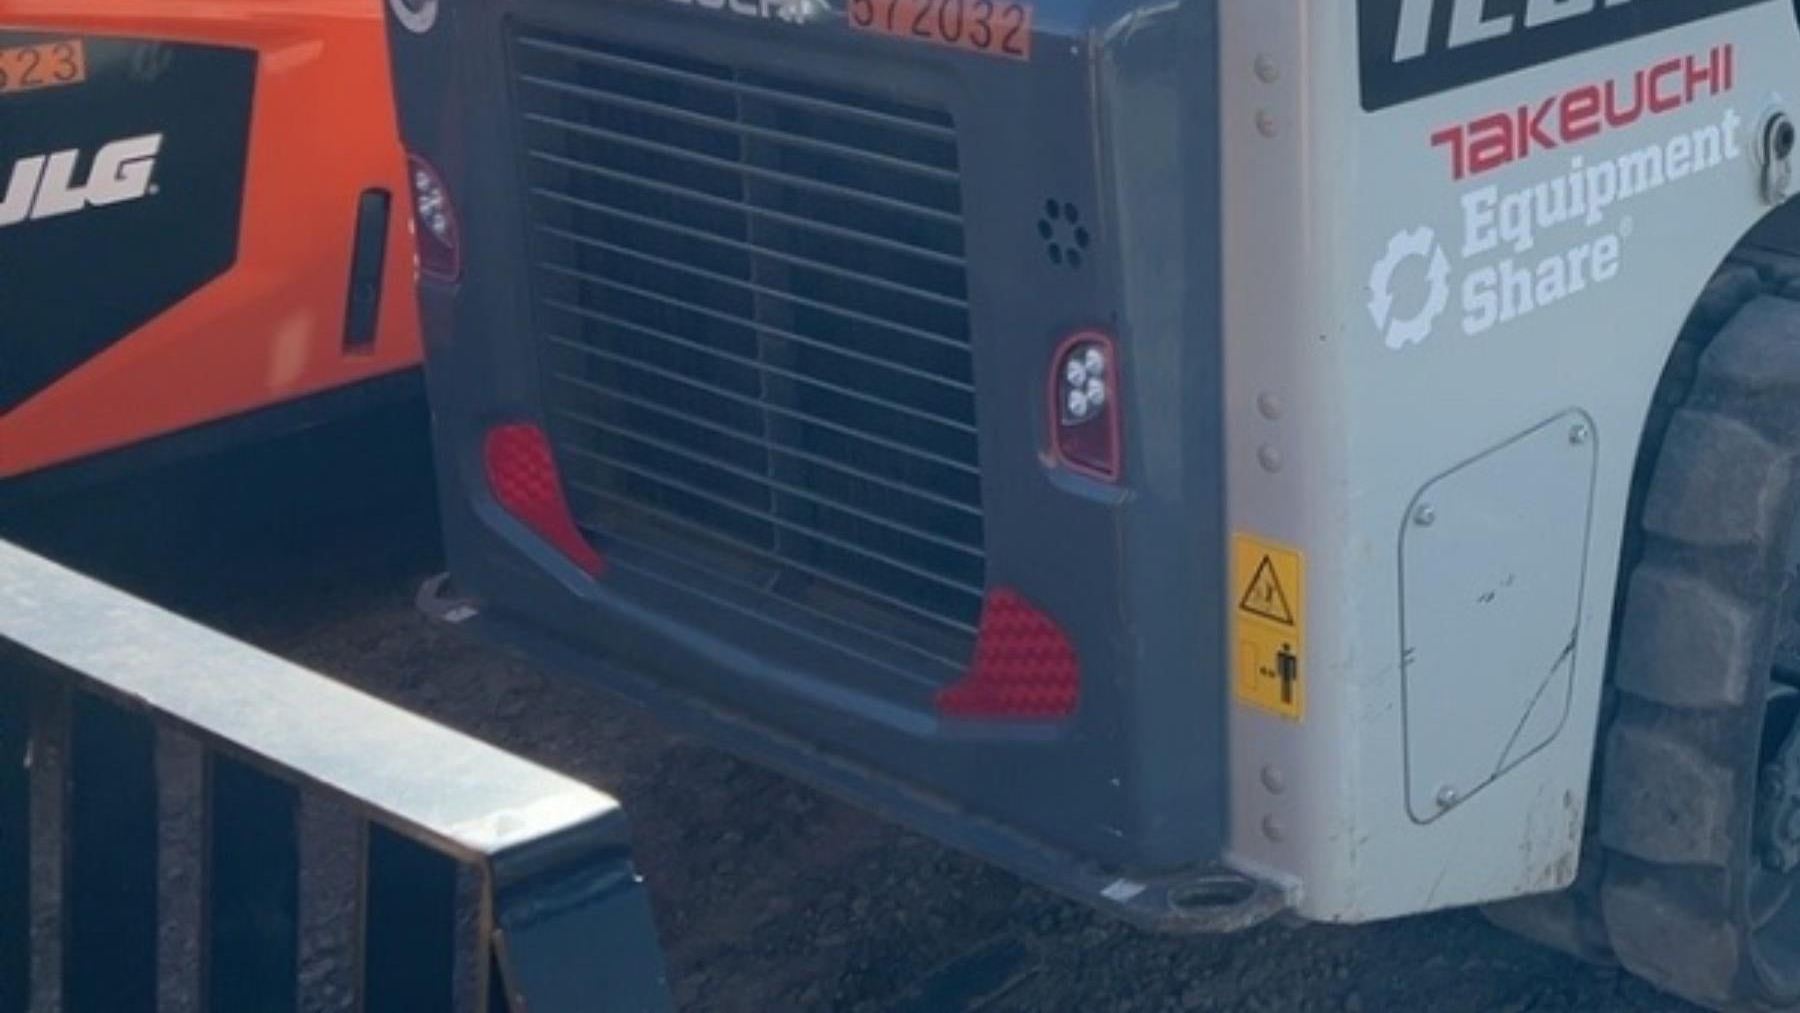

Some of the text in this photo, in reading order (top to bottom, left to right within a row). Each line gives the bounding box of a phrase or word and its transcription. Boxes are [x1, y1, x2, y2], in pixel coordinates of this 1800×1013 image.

[0, 133, 163, 227] JLG
[1460, 107, 1742, 258] Equipment
[1461, 233, 1620, 336] Share
